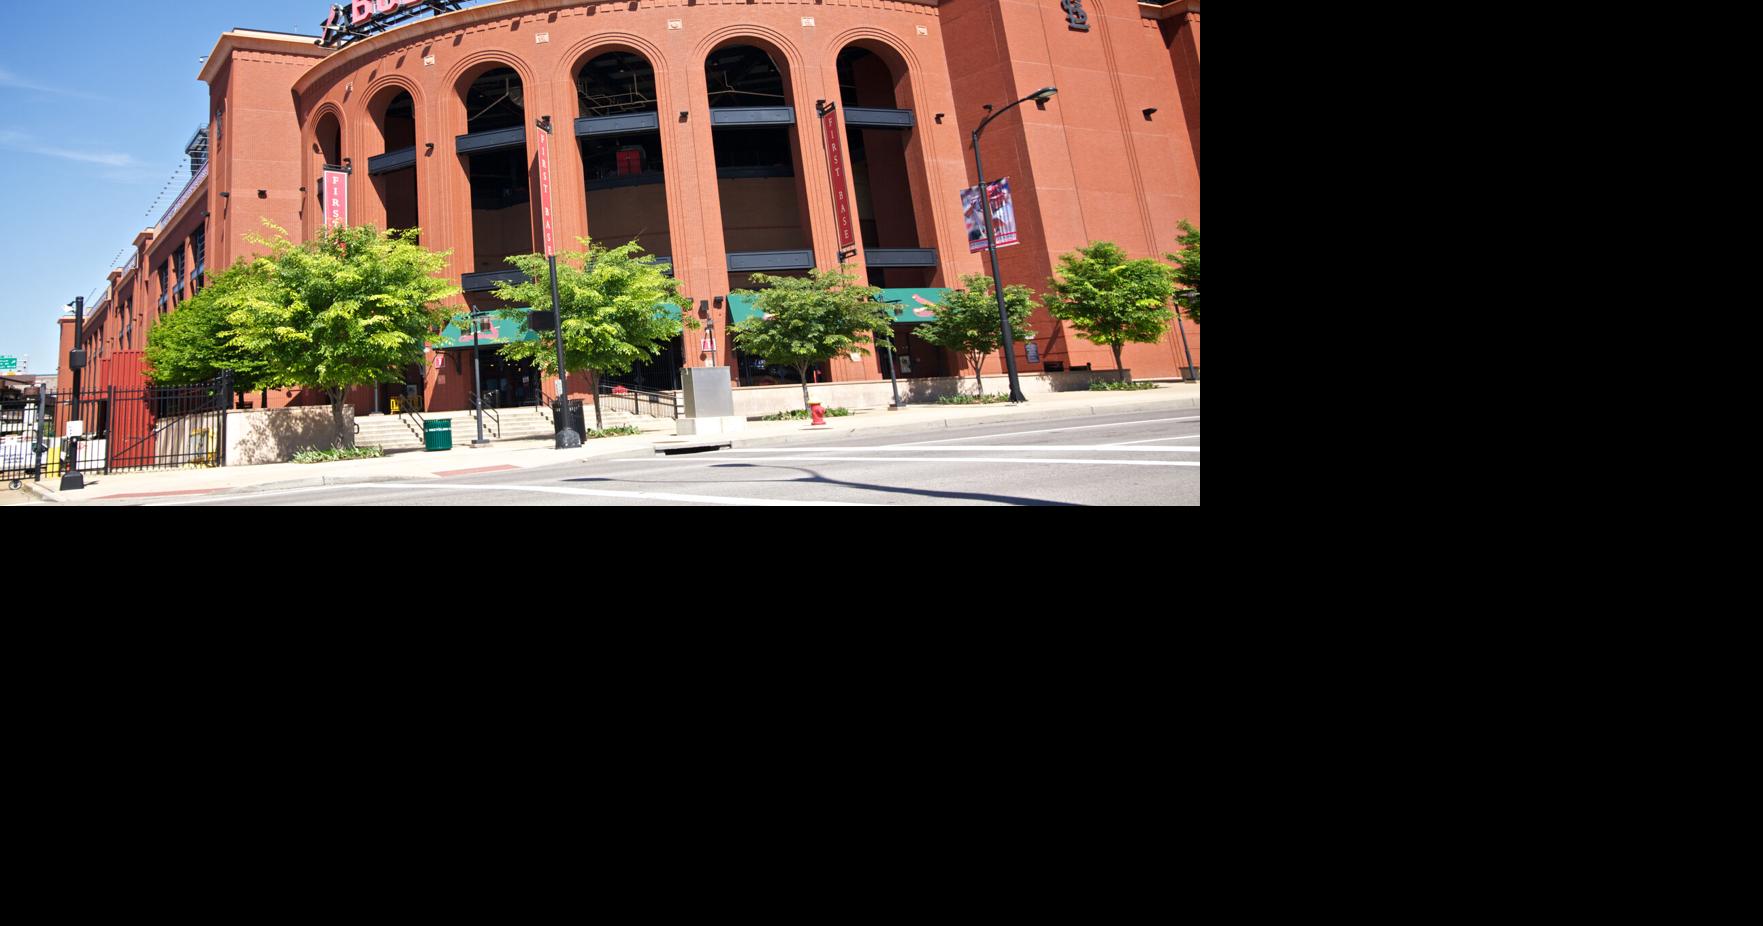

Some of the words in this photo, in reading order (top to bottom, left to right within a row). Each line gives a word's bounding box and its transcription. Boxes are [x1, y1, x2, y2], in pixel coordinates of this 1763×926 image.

[540, 134, 549, 193] FIRST
[829, 117, 840, 177] FIRST
[838, 191, 849, 239] BASE
[544, 207, 553, 255] BASE
